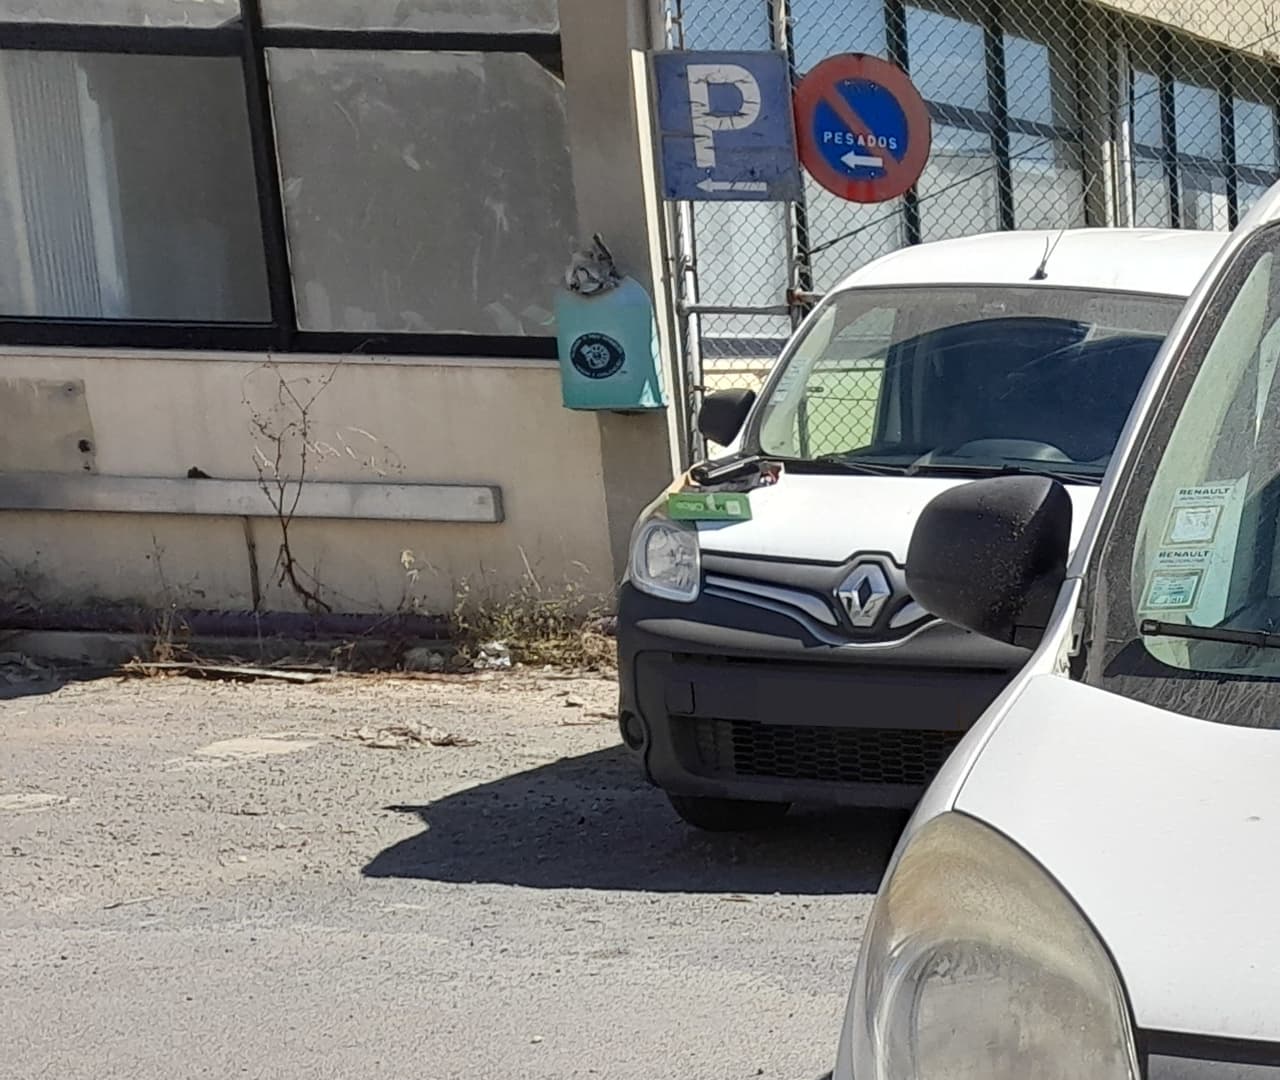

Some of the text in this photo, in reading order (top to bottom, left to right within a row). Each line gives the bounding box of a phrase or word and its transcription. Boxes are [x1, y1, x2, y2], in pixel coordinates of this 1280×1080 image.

[686, 64, 761, 168] P
[823, 131, 898, 149] PESADOS
[1159, 550, 1209, 558] RENAULT
